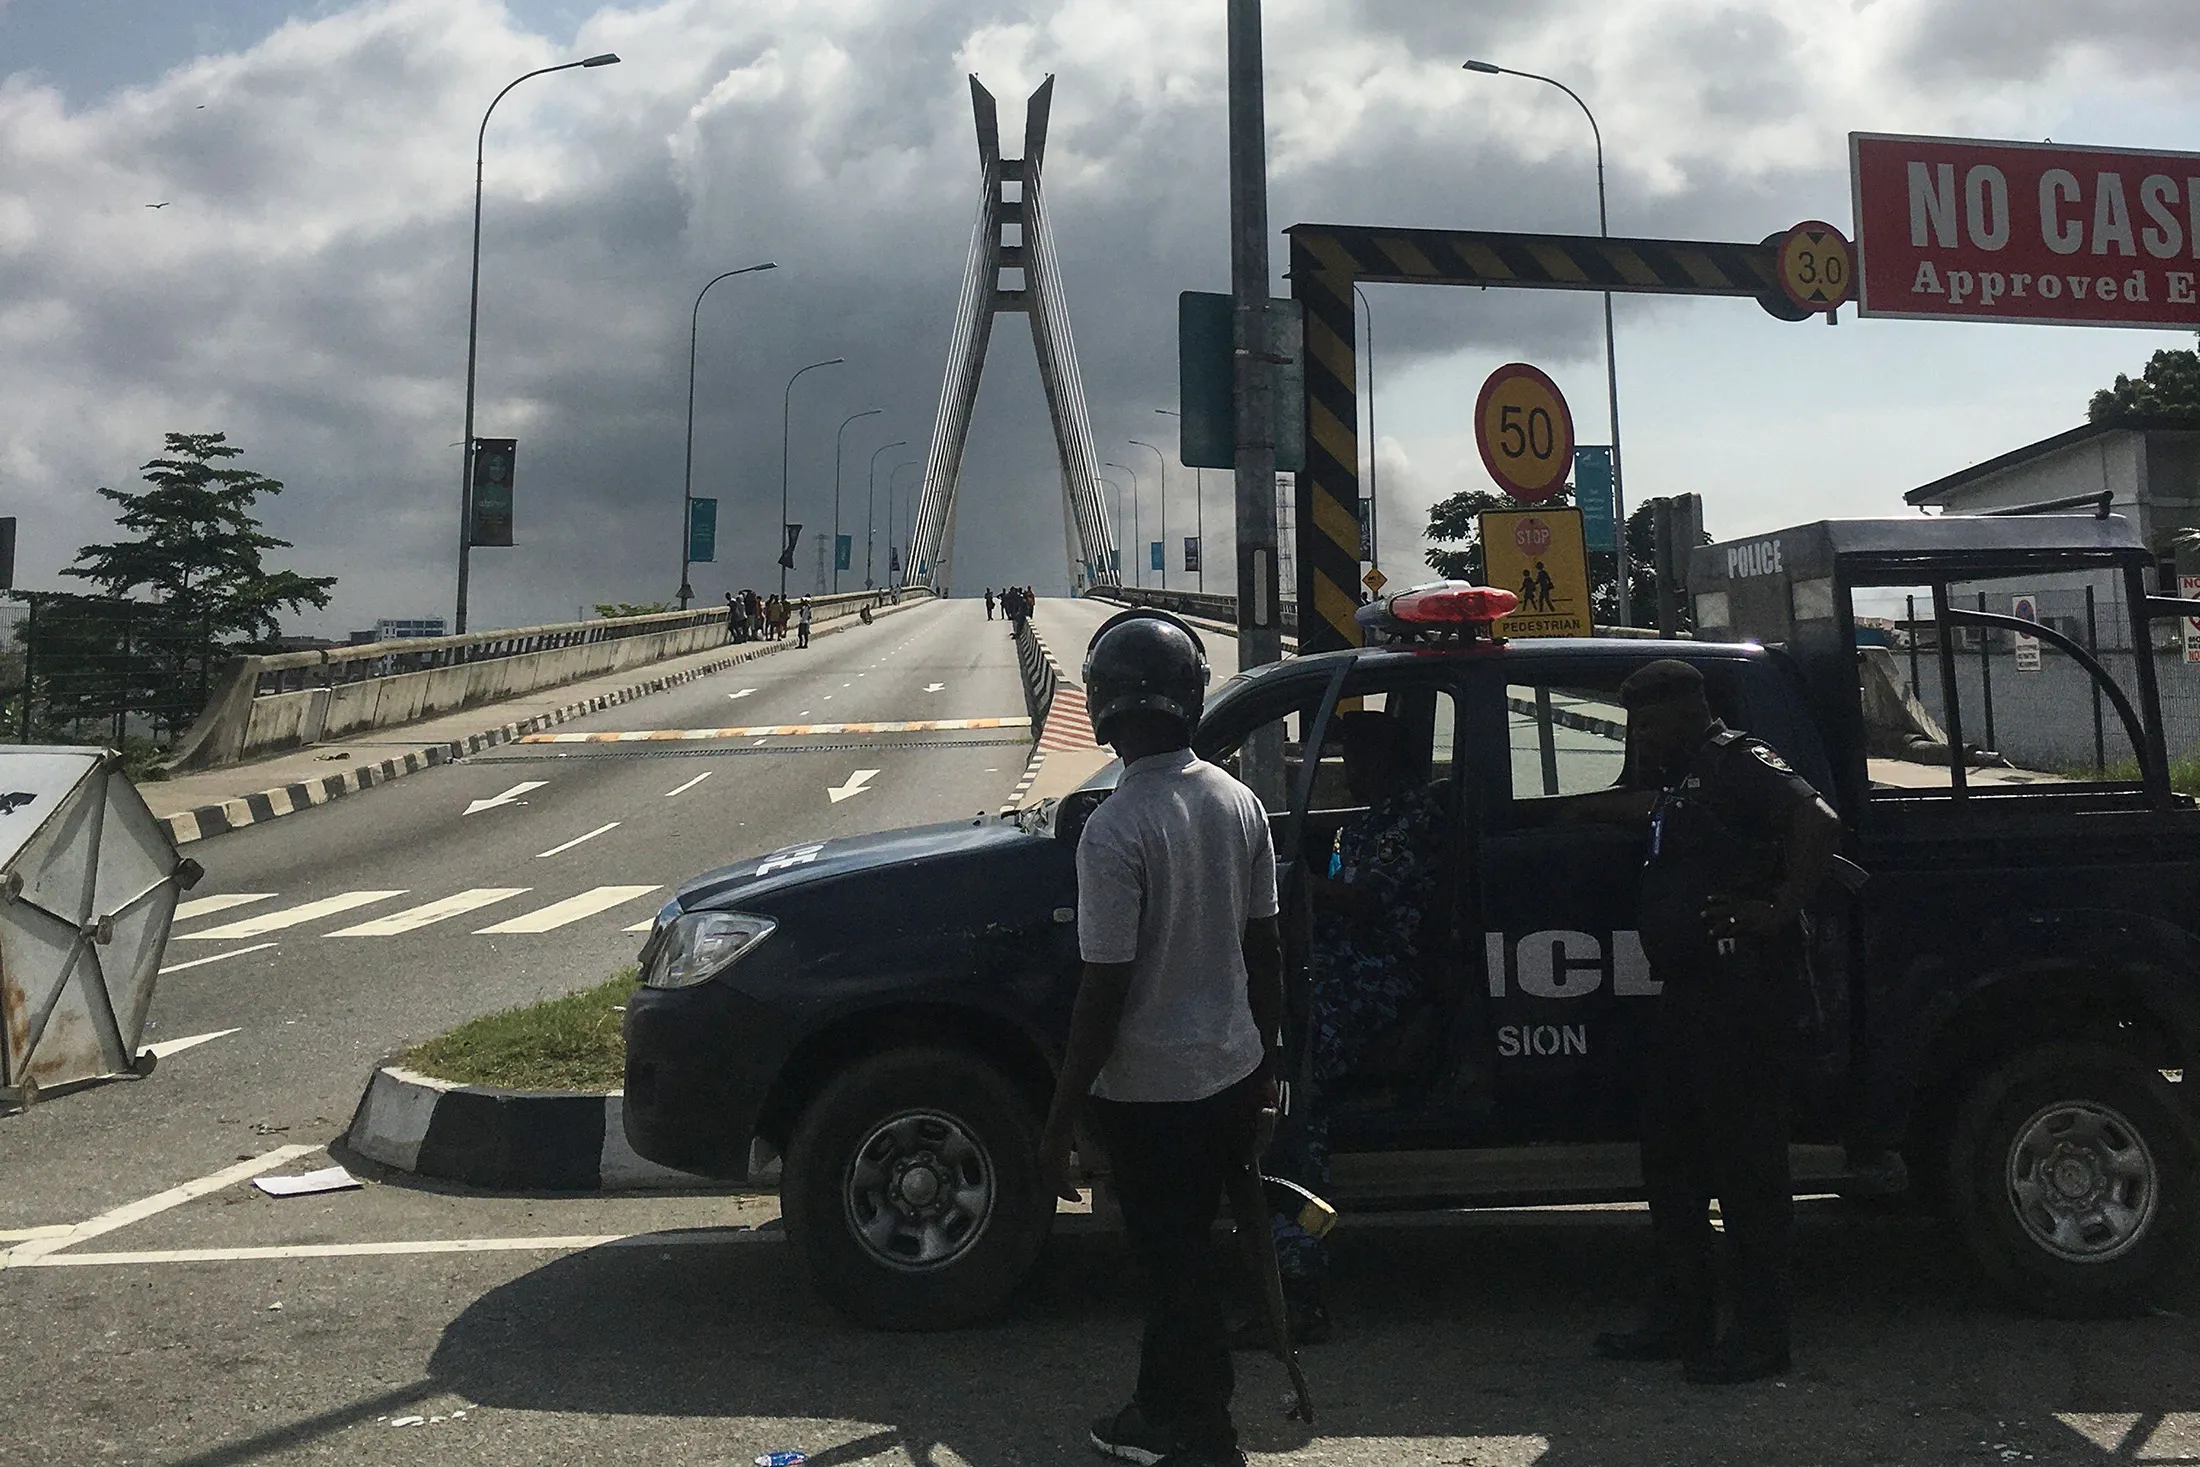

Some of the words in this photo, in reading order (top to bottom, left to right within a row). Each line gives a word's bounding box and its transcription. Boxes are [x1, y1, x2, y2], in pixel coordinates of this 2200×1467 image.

[1907, 161, 2010, 251] NO
[1797, 251, 1842, 285] 3.0
[1911, 261, 2149, 305] Approved
[1501, 405, 1553, 460] 50
[1516, 528, 1550, 545] STOP
[1727, 539, 1783, 579] POLICE
[1503, 619, 1580, 632] PEDESTRIAN
[1497, 1024, 1588, 1056] SION
